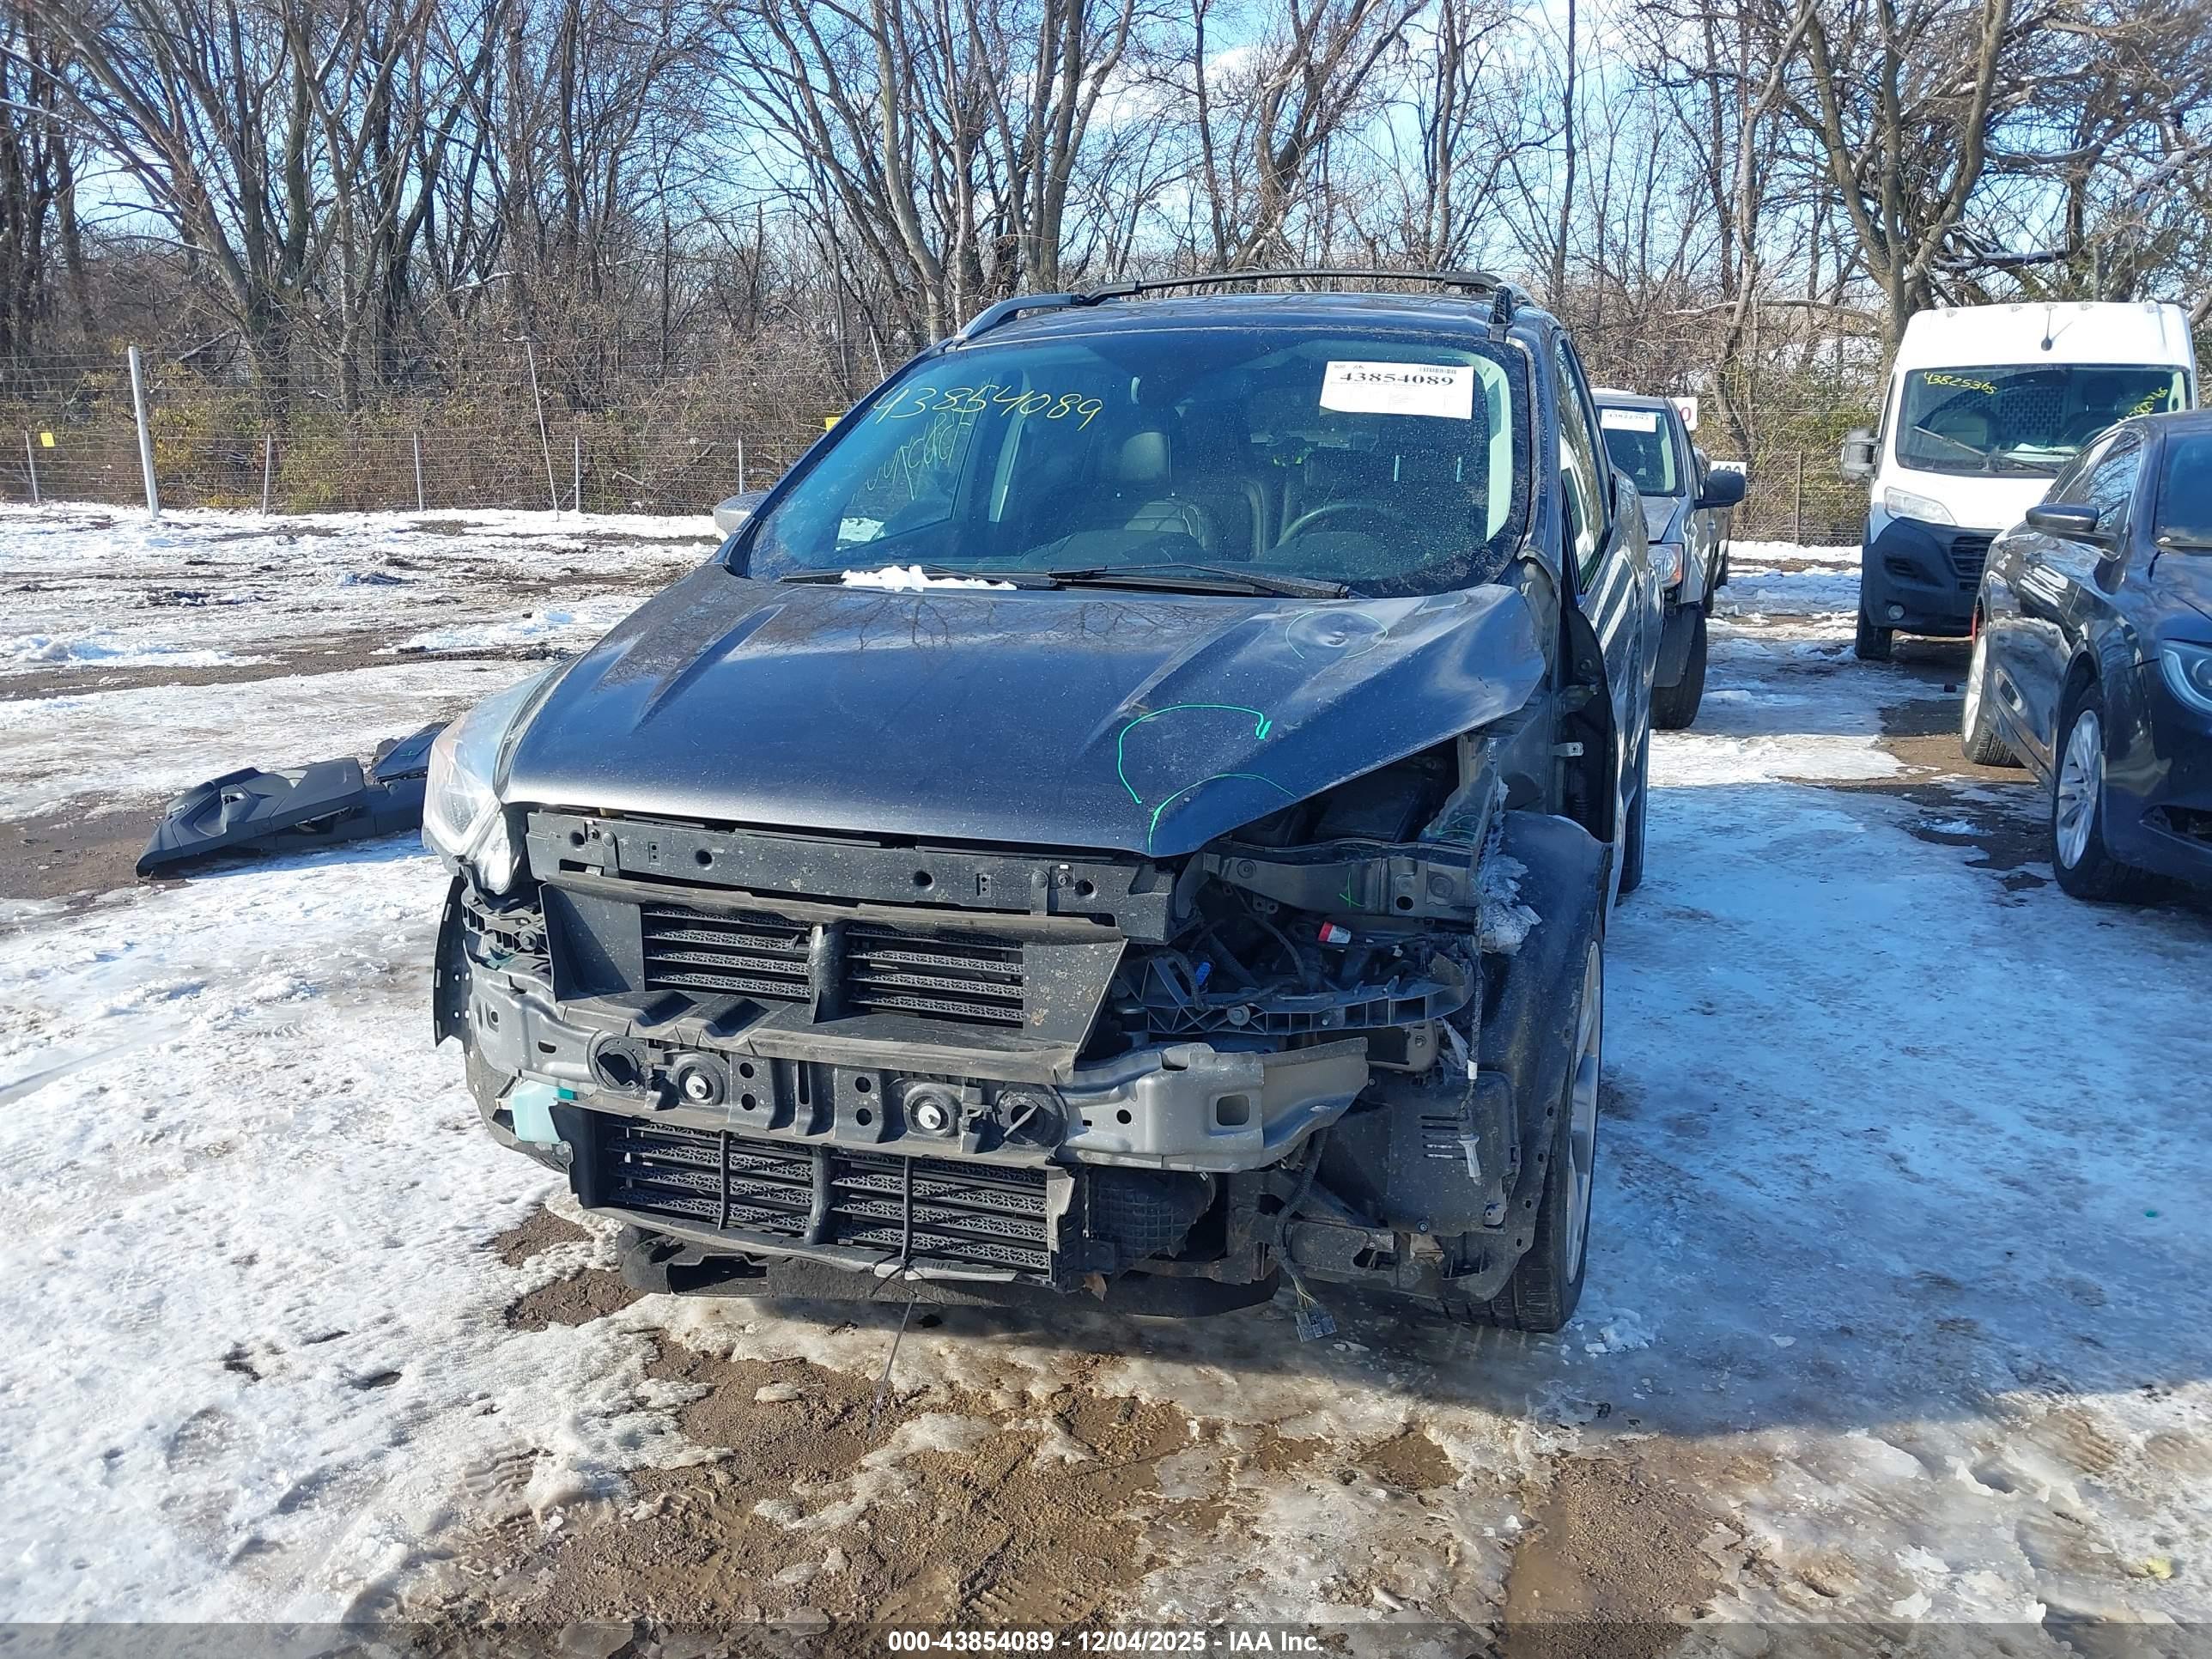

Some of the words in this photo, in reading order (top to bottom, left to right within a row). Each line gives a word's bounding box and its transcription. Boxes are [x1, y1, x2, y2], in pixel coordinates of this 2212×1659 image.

[1340, 372, 1455, 386] 43854089
[1923, 371, 1998, 394] 43825365
[872, 383, 1103, 432] 43854089
